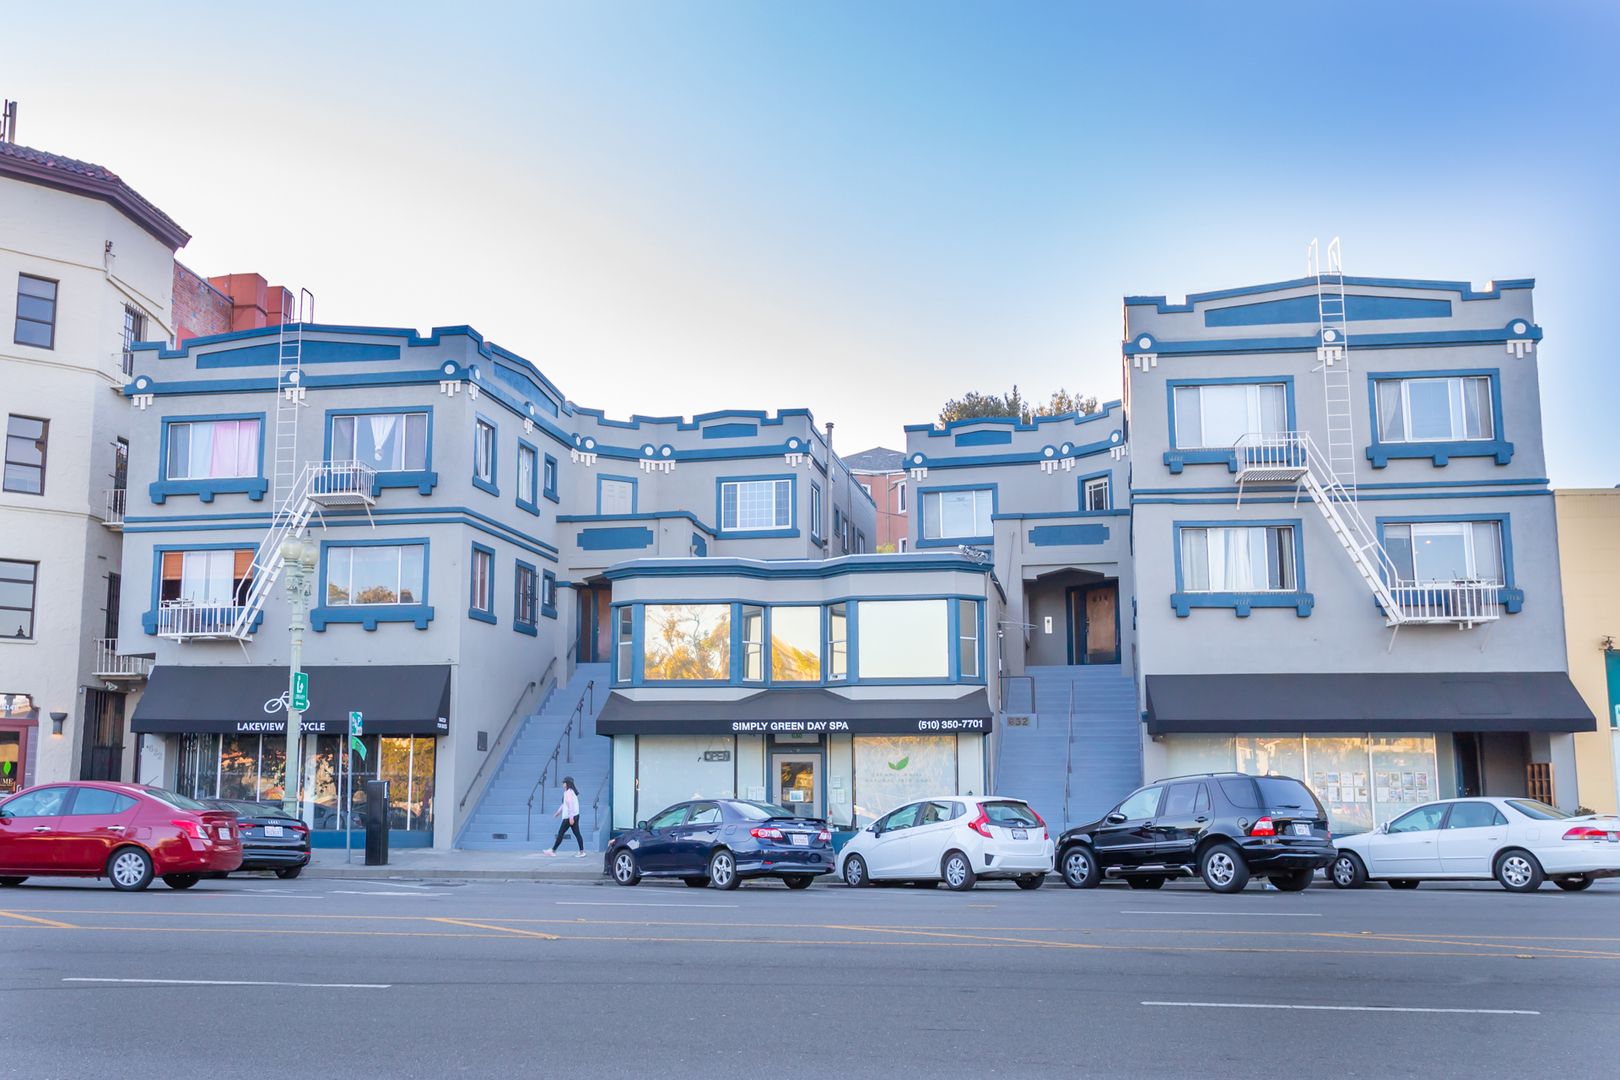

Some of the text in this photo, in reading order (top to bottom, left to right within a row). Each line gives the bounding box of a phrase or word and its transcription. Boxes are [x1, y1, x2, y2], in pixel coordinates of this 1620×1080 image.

[237, 722, 326, 731] LAKEVIEW YCLE
[732, 721, 849, 731] SIMPLY GREEN DAY SPA
[918, 719, 984, 730] (510) 350-7701
[705, 751, 730, 760] OPEN
